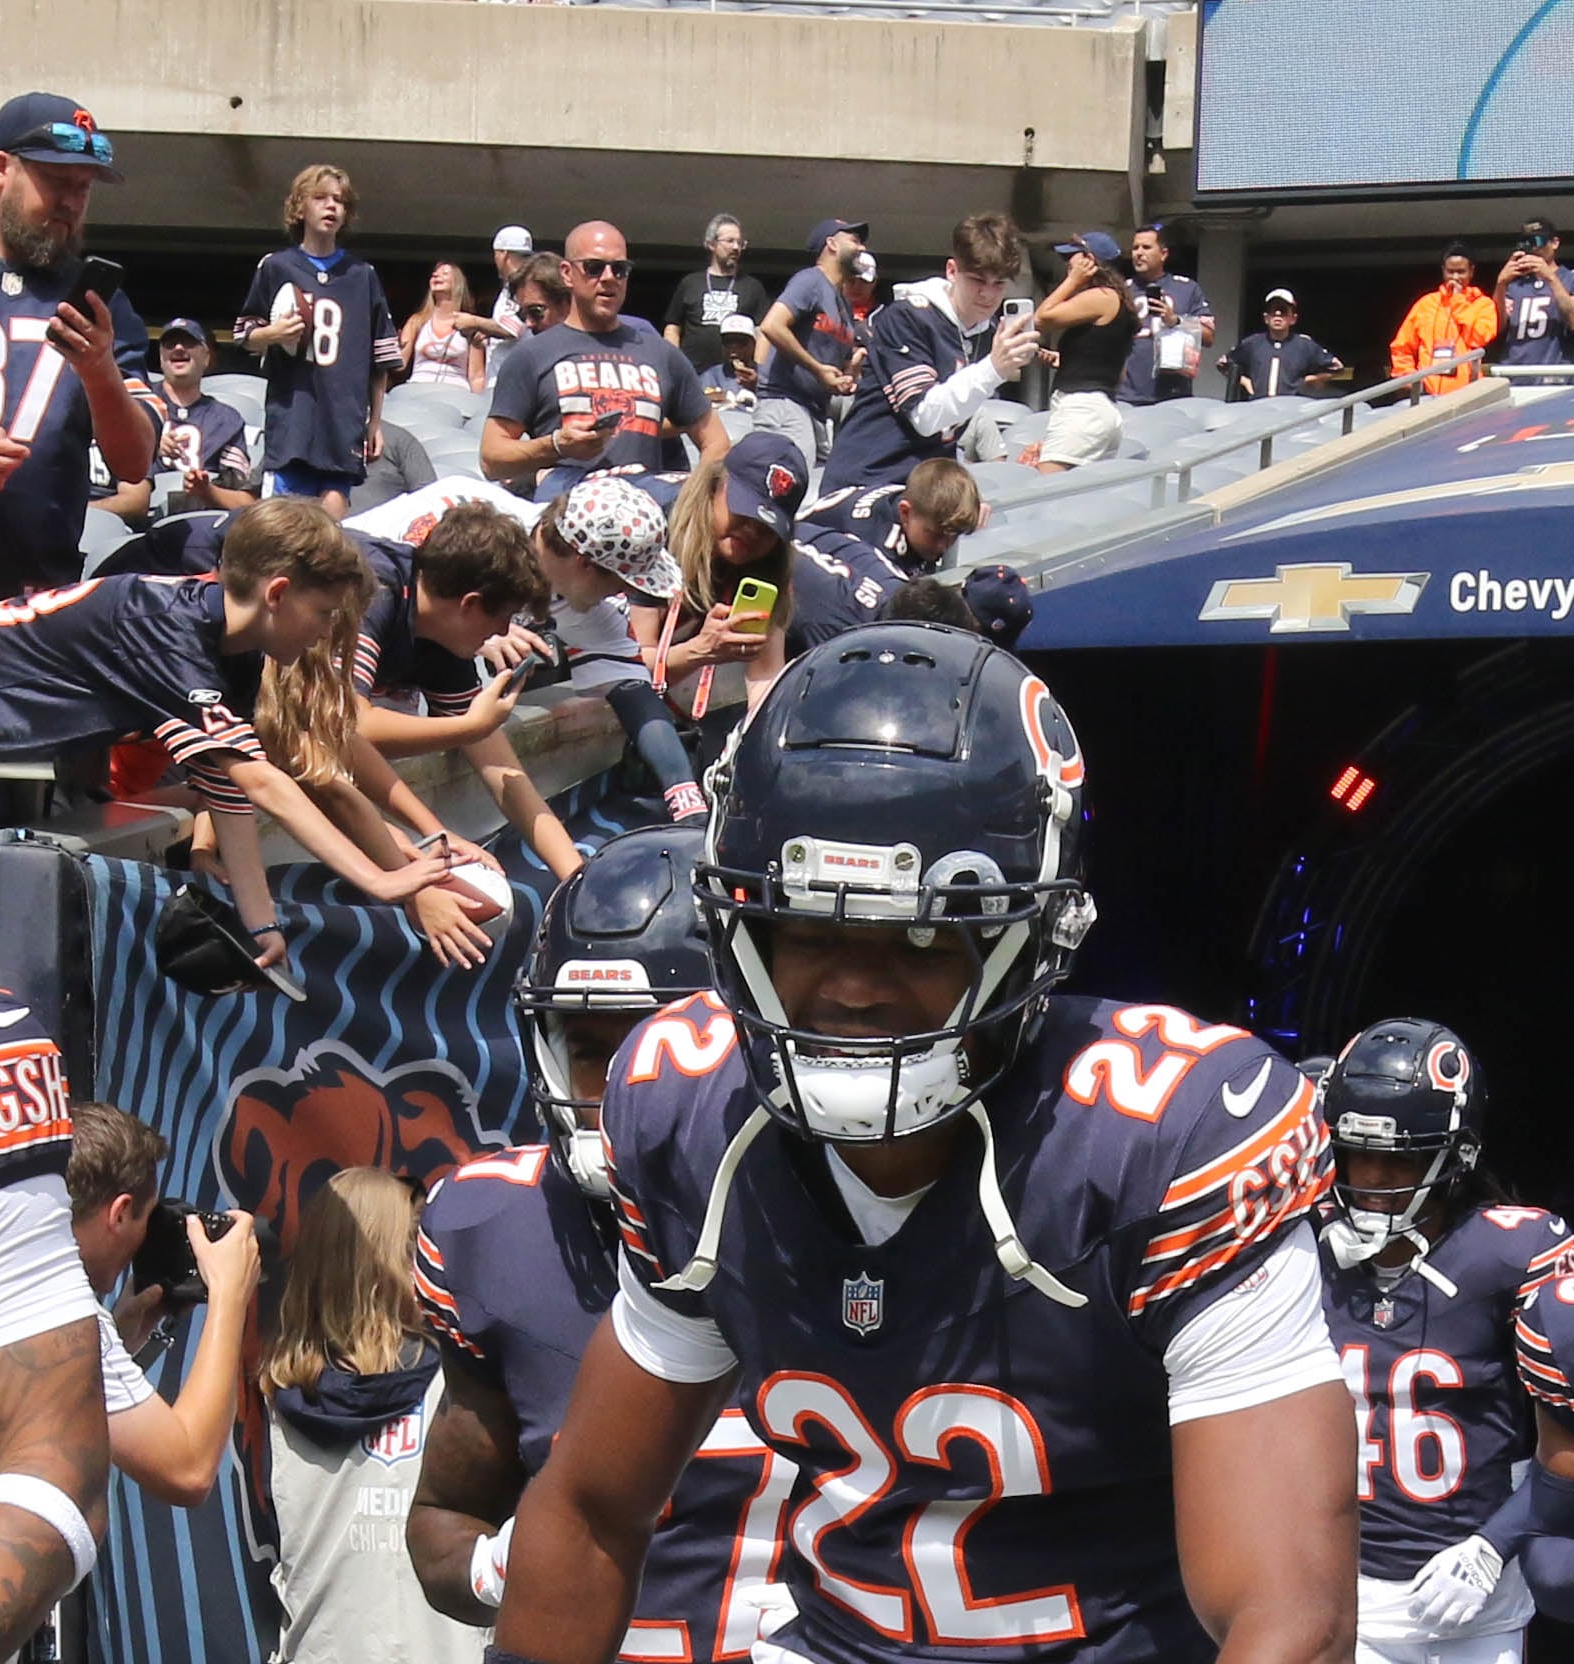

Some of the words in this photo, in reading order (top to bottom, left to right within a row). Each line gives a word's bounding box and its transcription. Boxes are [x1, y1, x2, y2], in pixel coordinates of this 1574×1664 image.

[303, 292, 343, 367] 8
[1516, 296, 1549, 341] 15
[554, 360, 661, 397] BEARS
[823, 854, 881, 871] BEARS
[567, 969, 633, 981] BEARS
[849, 1301, 877, 1322] NFL
[1340, 1344, 1467, 1503] 46
[354, 1486, 414, 1517] MEDI
[757, 1369, 1087, 1647] 22
[349, 1522, 406, 1553] CHI-0
[618, 1408, 801, 1664] 7
